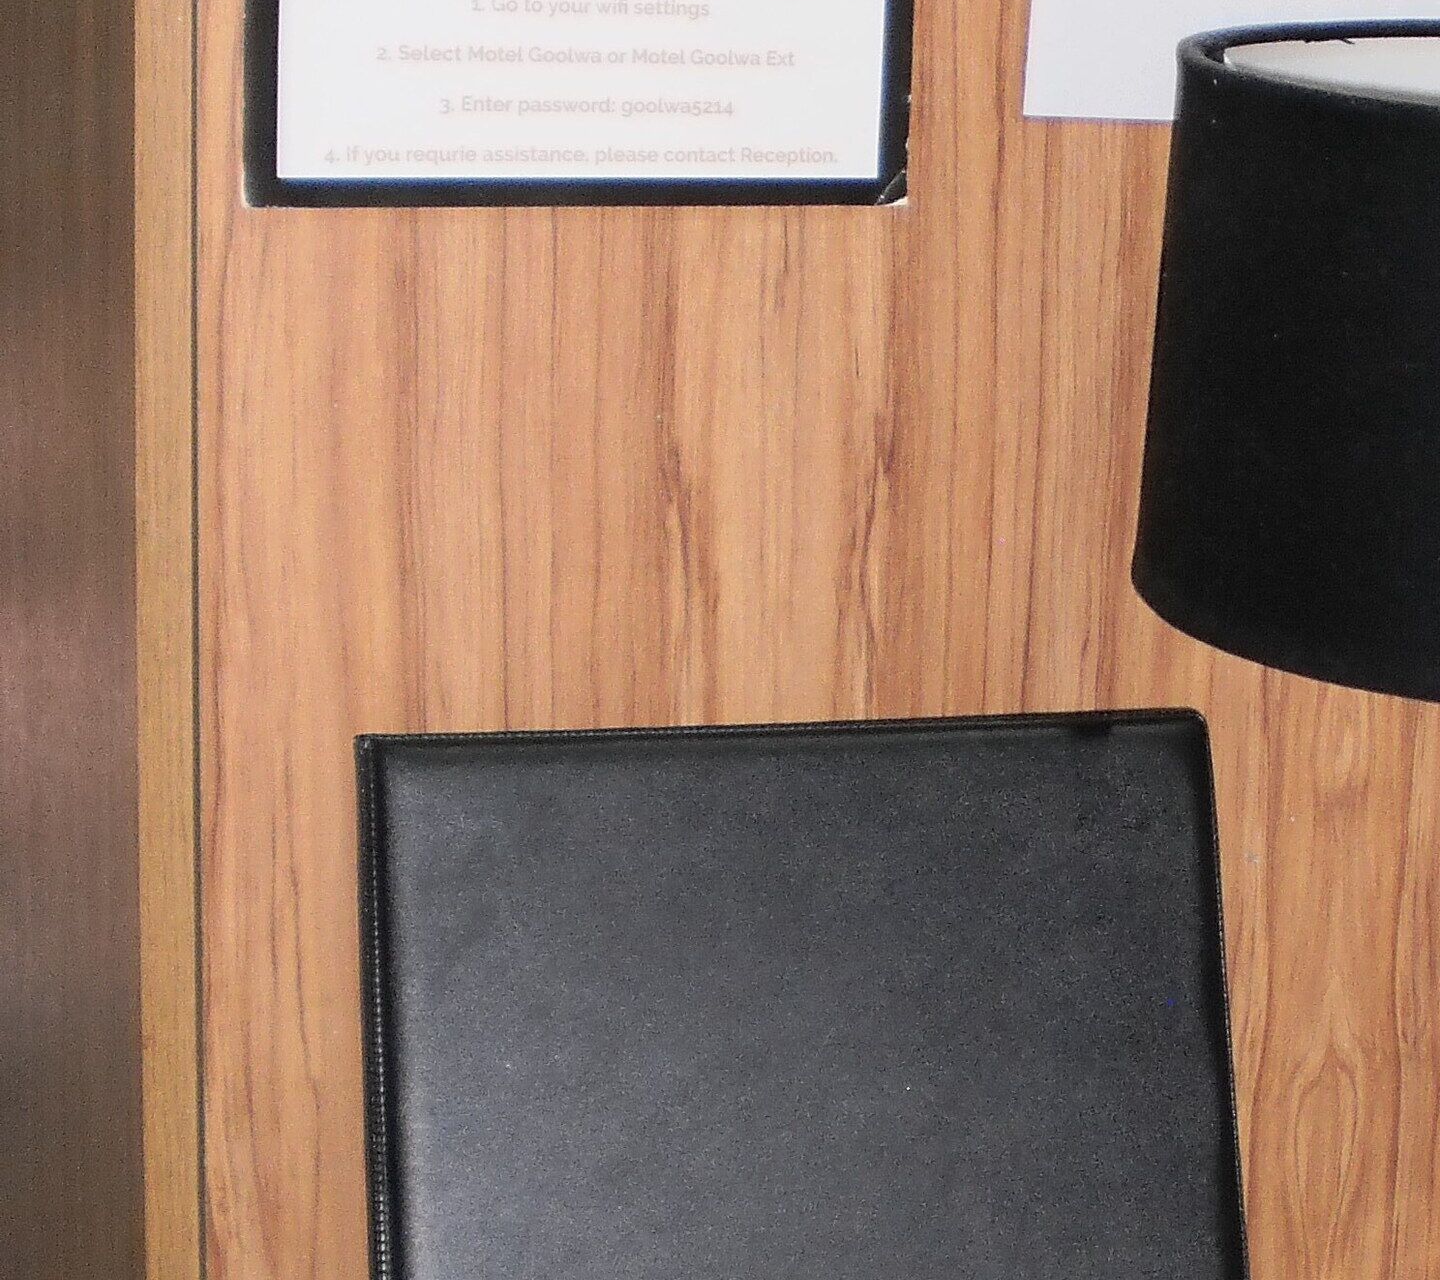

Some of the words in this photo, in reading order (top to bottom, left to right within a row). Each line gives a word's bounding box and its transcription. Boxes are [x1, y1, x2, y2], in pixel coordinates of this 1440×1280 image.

[472, 0, 485, 12] 1.
[549, 0, 591, 18] your
[634, 0, 710, 21] settings
[376, 48, 391, 61] 2.
[398, 44, 462, 62] Select
[468, 46, 524, 63] Motel
[528, 47, 602, 65] Goolwa
[607, 51, 625, 64] or
[631, 48, 685, 65] Motel
[690, 49, 760, 66] Goolwa
[766, 51, 795, 66] Ext
[439, 99, 455, 114] 3.
[461, 95, 513, 113] Enter
[518, 96, 615, 116] password:
[621, 99, 734, 117] goolwa5214
[324, 149, 340, 164] 4.
[363, 149, 401, 166] you
[595, 148, 658, 165] please
[663, 149, 735, 163] contact
[741, 147, 838, 165] Reception.
